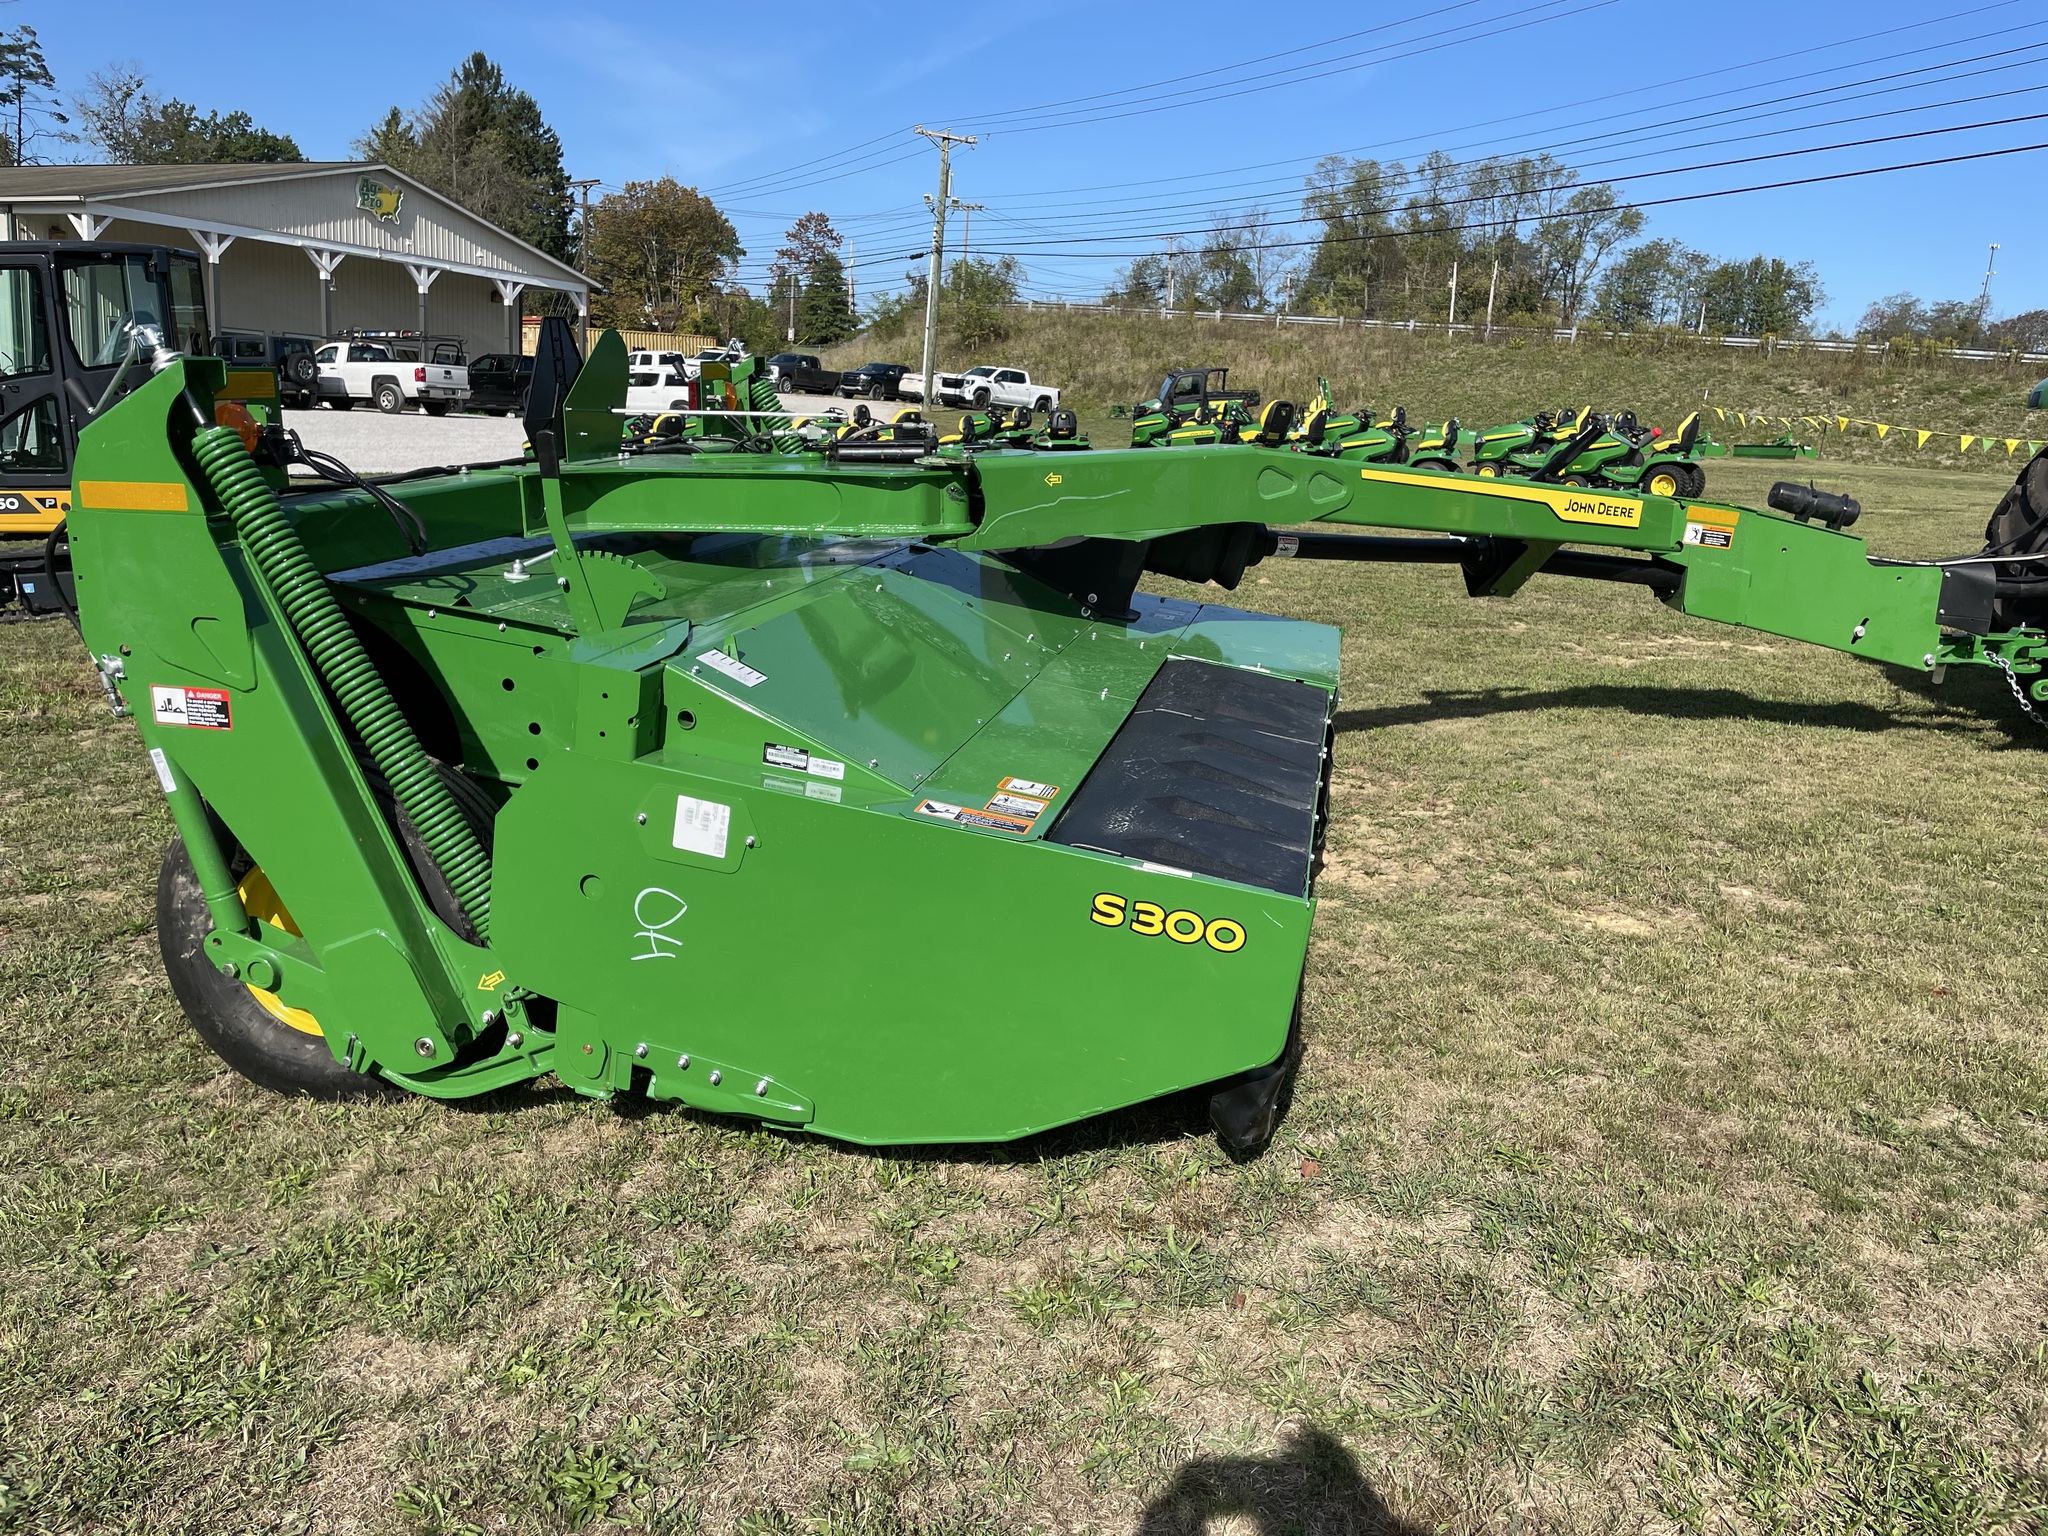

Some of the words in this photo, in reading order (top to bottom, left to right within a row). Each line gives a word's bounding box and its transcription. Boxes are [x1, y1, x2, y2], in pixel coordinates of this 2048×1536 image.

[361, 178, 382, 196] Ag-
[361, 193, 383, 209] Pro
[46, 499, 55, 508] P
[1564, 499, 1596, 514] JOHN
[1597, 502, 1635, 518] DEERE
[196, 692, 222, 700] DANGER
